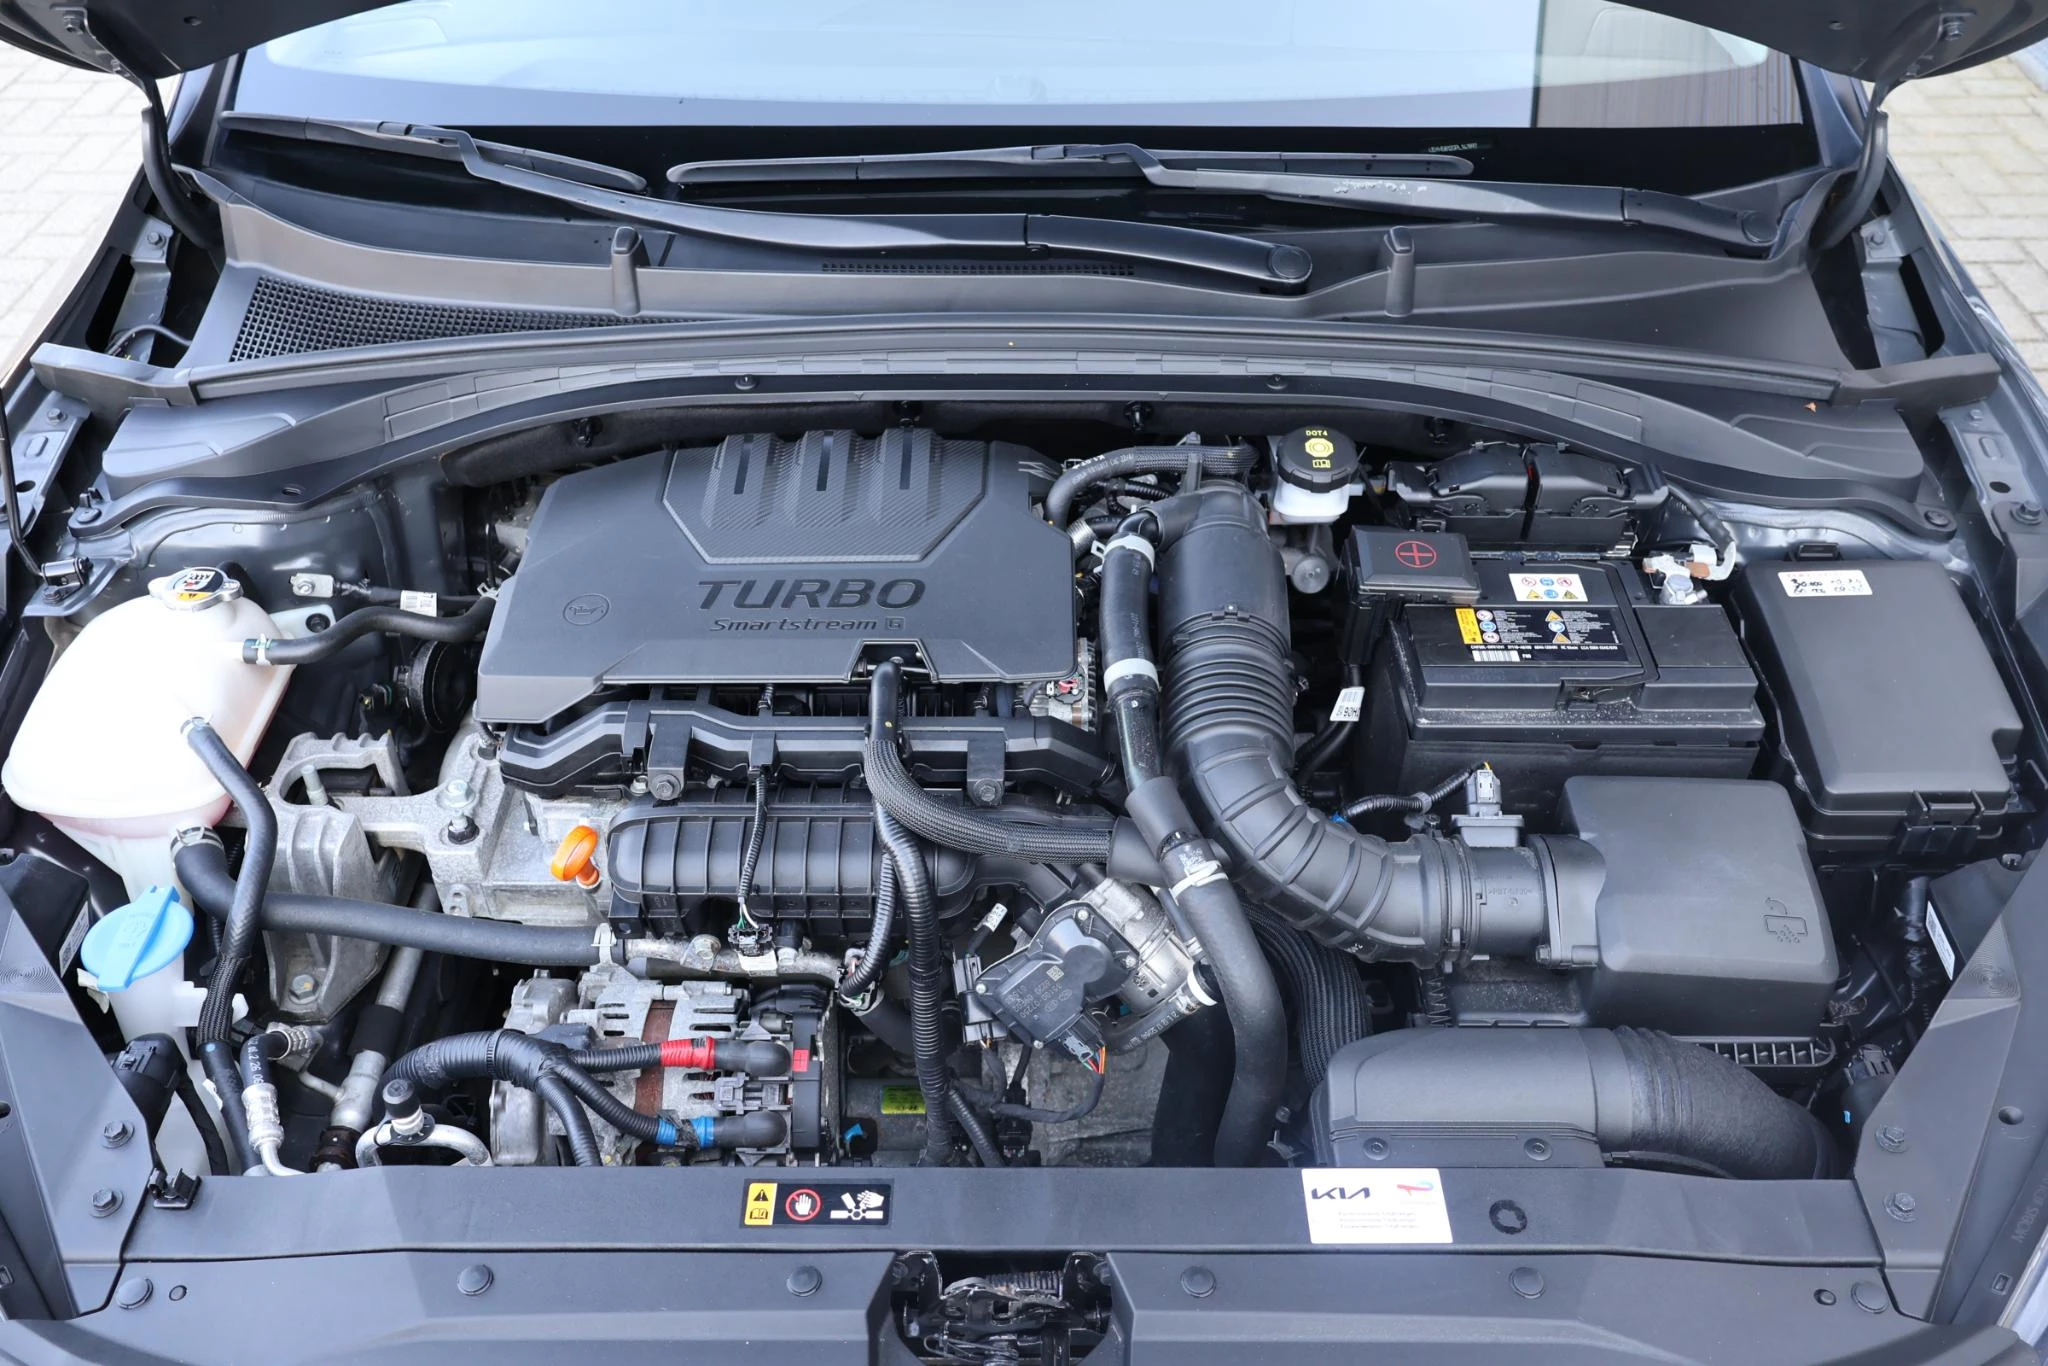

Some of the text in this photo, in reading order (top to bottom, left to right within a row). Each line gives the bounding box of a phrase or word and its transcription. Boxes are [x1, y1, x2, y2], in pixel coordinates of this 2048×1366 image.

[1305, 429, 1328, 437] DOT4
[698, 578, 926, 610] TURBO
[709, 617, 877, 632] Smartstream
[1311, 1186, 1371, 1200] KIA
[2011, 1206, 2039, 1244] MOBIS
